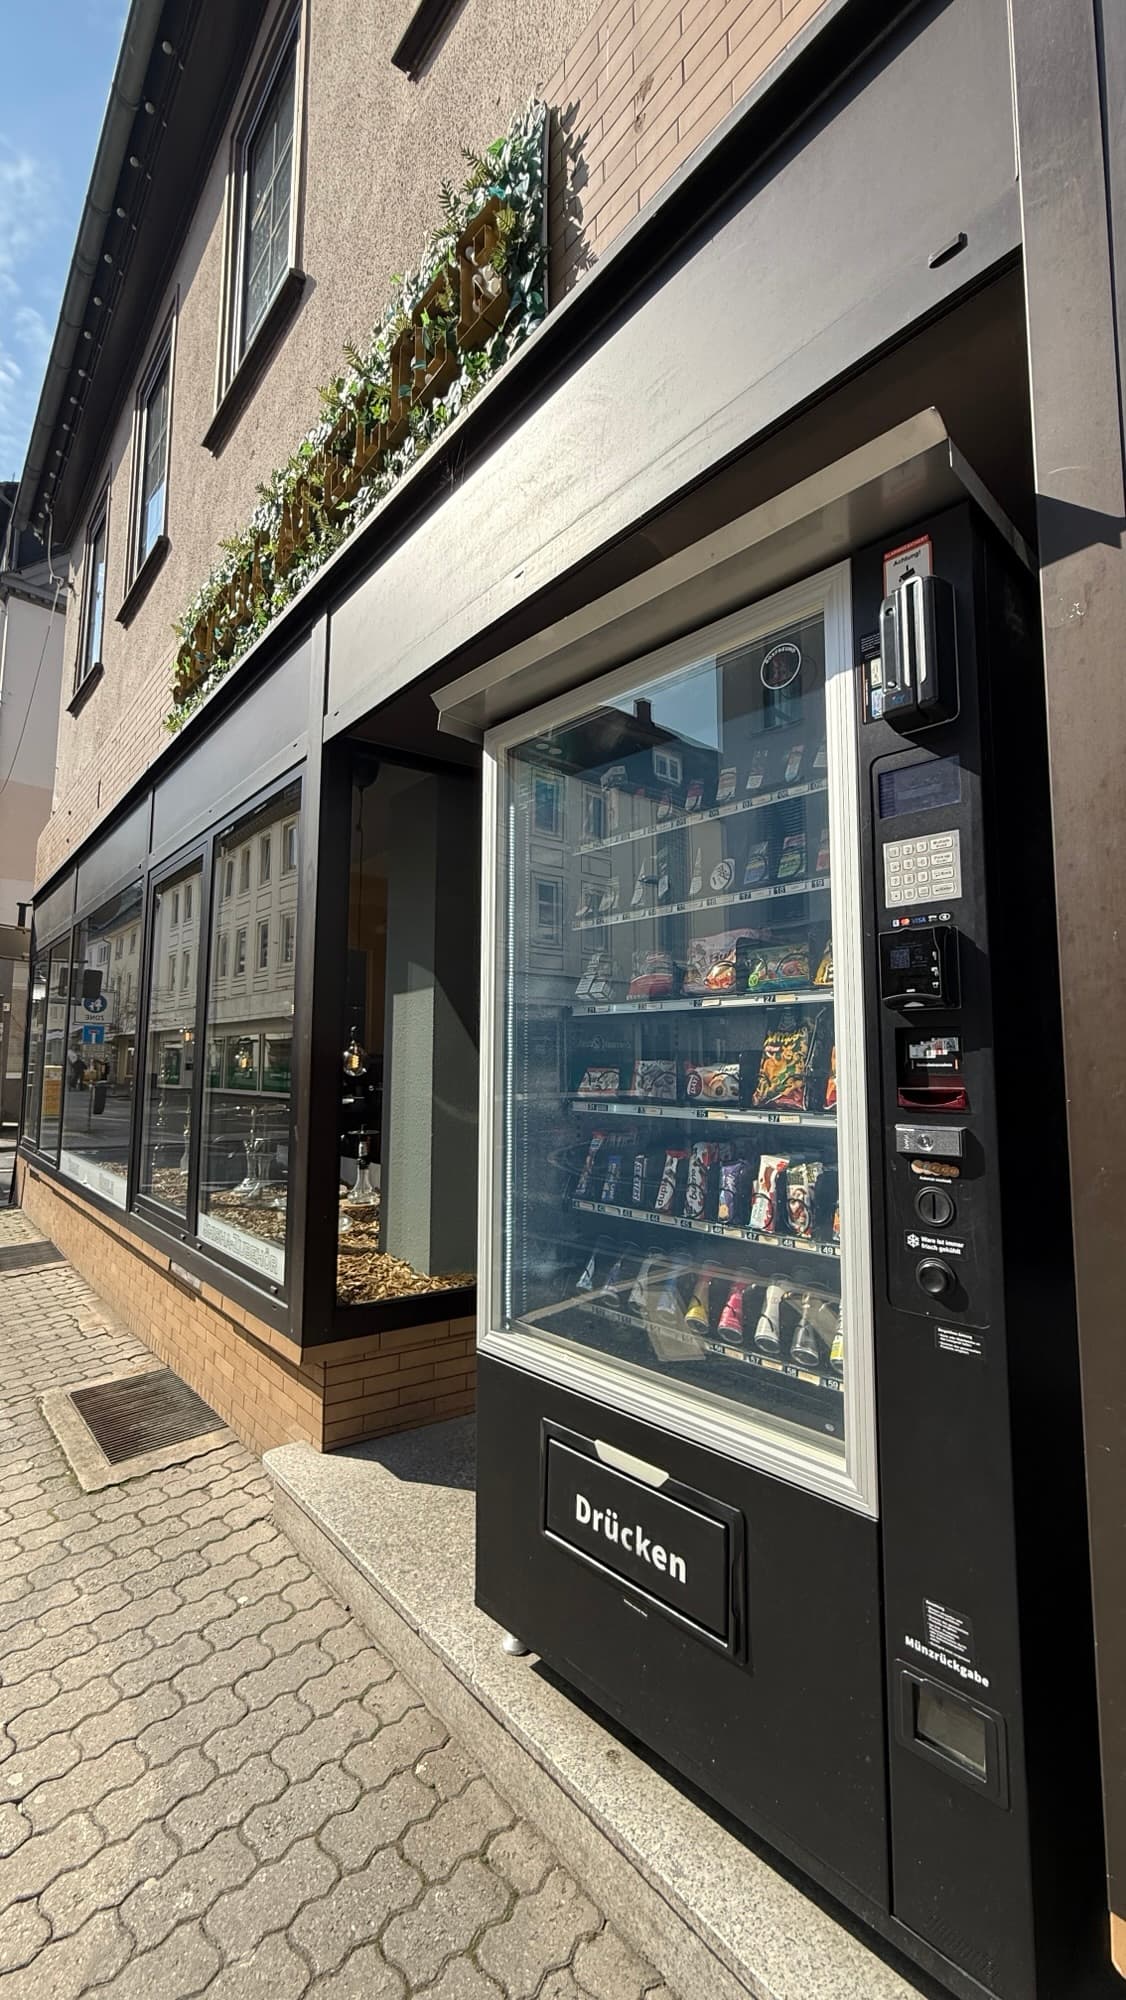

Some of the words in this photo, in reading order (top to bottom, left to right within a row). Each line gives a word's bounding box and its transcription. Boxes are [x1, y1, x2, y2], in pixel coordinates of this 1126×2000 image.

[893, 550, 921, 566] Achtung!
[575, 1493, 687, 1585] Drücken
[905, 1635, 990, 1687] Münzrückgabe
